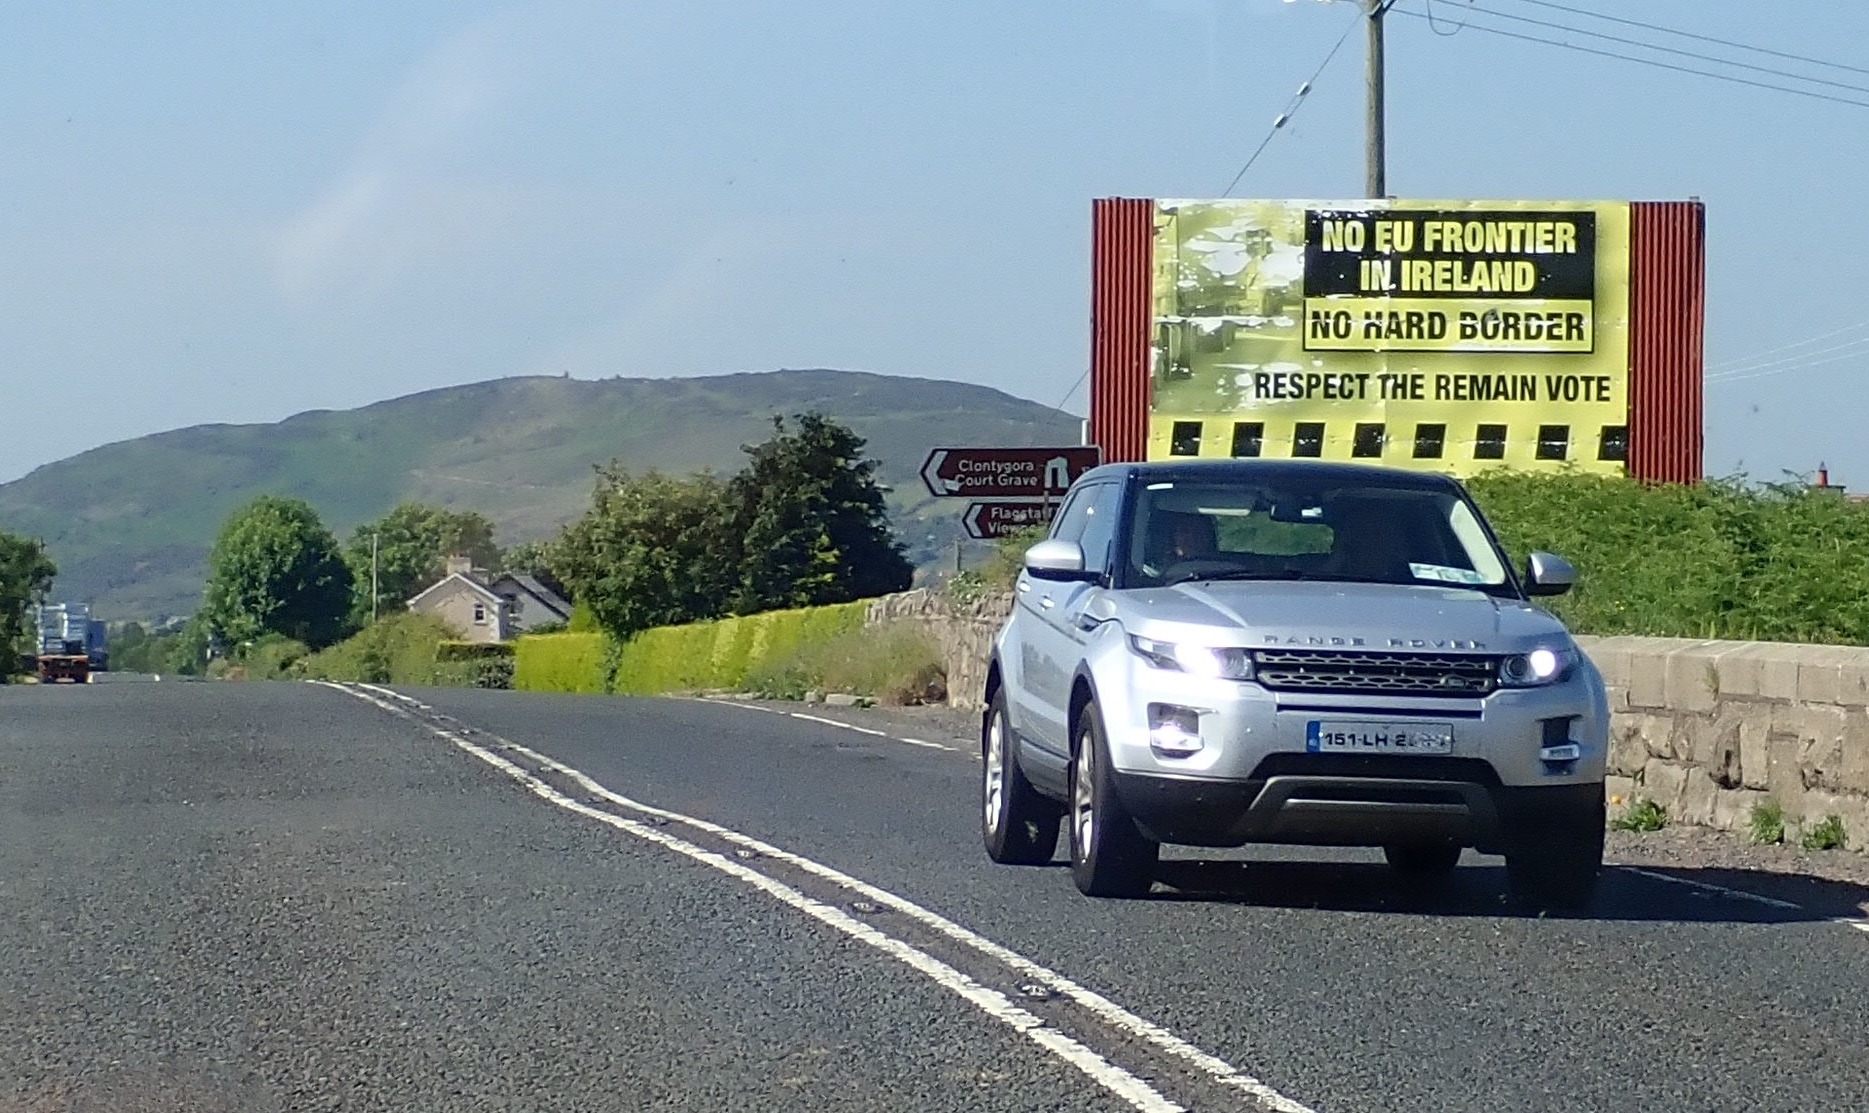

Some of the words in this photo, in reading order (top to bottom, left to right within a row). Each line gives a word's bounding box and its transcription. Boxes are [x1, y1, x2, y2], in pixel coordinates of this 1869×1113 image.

[1322, 221, 1364, 253] NO
[1376, 221, 1412, 253] EU
[1425, 221, 1575, 254] FRONTIER
[1360, 260, 1393, 291] IN
[1401, 261, 1534, 292] IRELAND
[1311, 311, 1352, 340] NO
[1364, 311, 1446, 340] HARD
[1460, 310, 1584, 341] BORDER
[1255, 373, 1370, 400] RESPECT
[1377, 374, 1425, 400] THE
[1435, 374, 1535, 401] REMAIN
[1545, 375, 1610, 402] VOTE
[956, 474, 994, 487] Court
[997, 475, 1038, 487] Grave
[958, 459, 1034, 473] Clontygora
[1264, 635, 1366, 646] RANGE
[1388, 638, 1487, 649] ROVER
